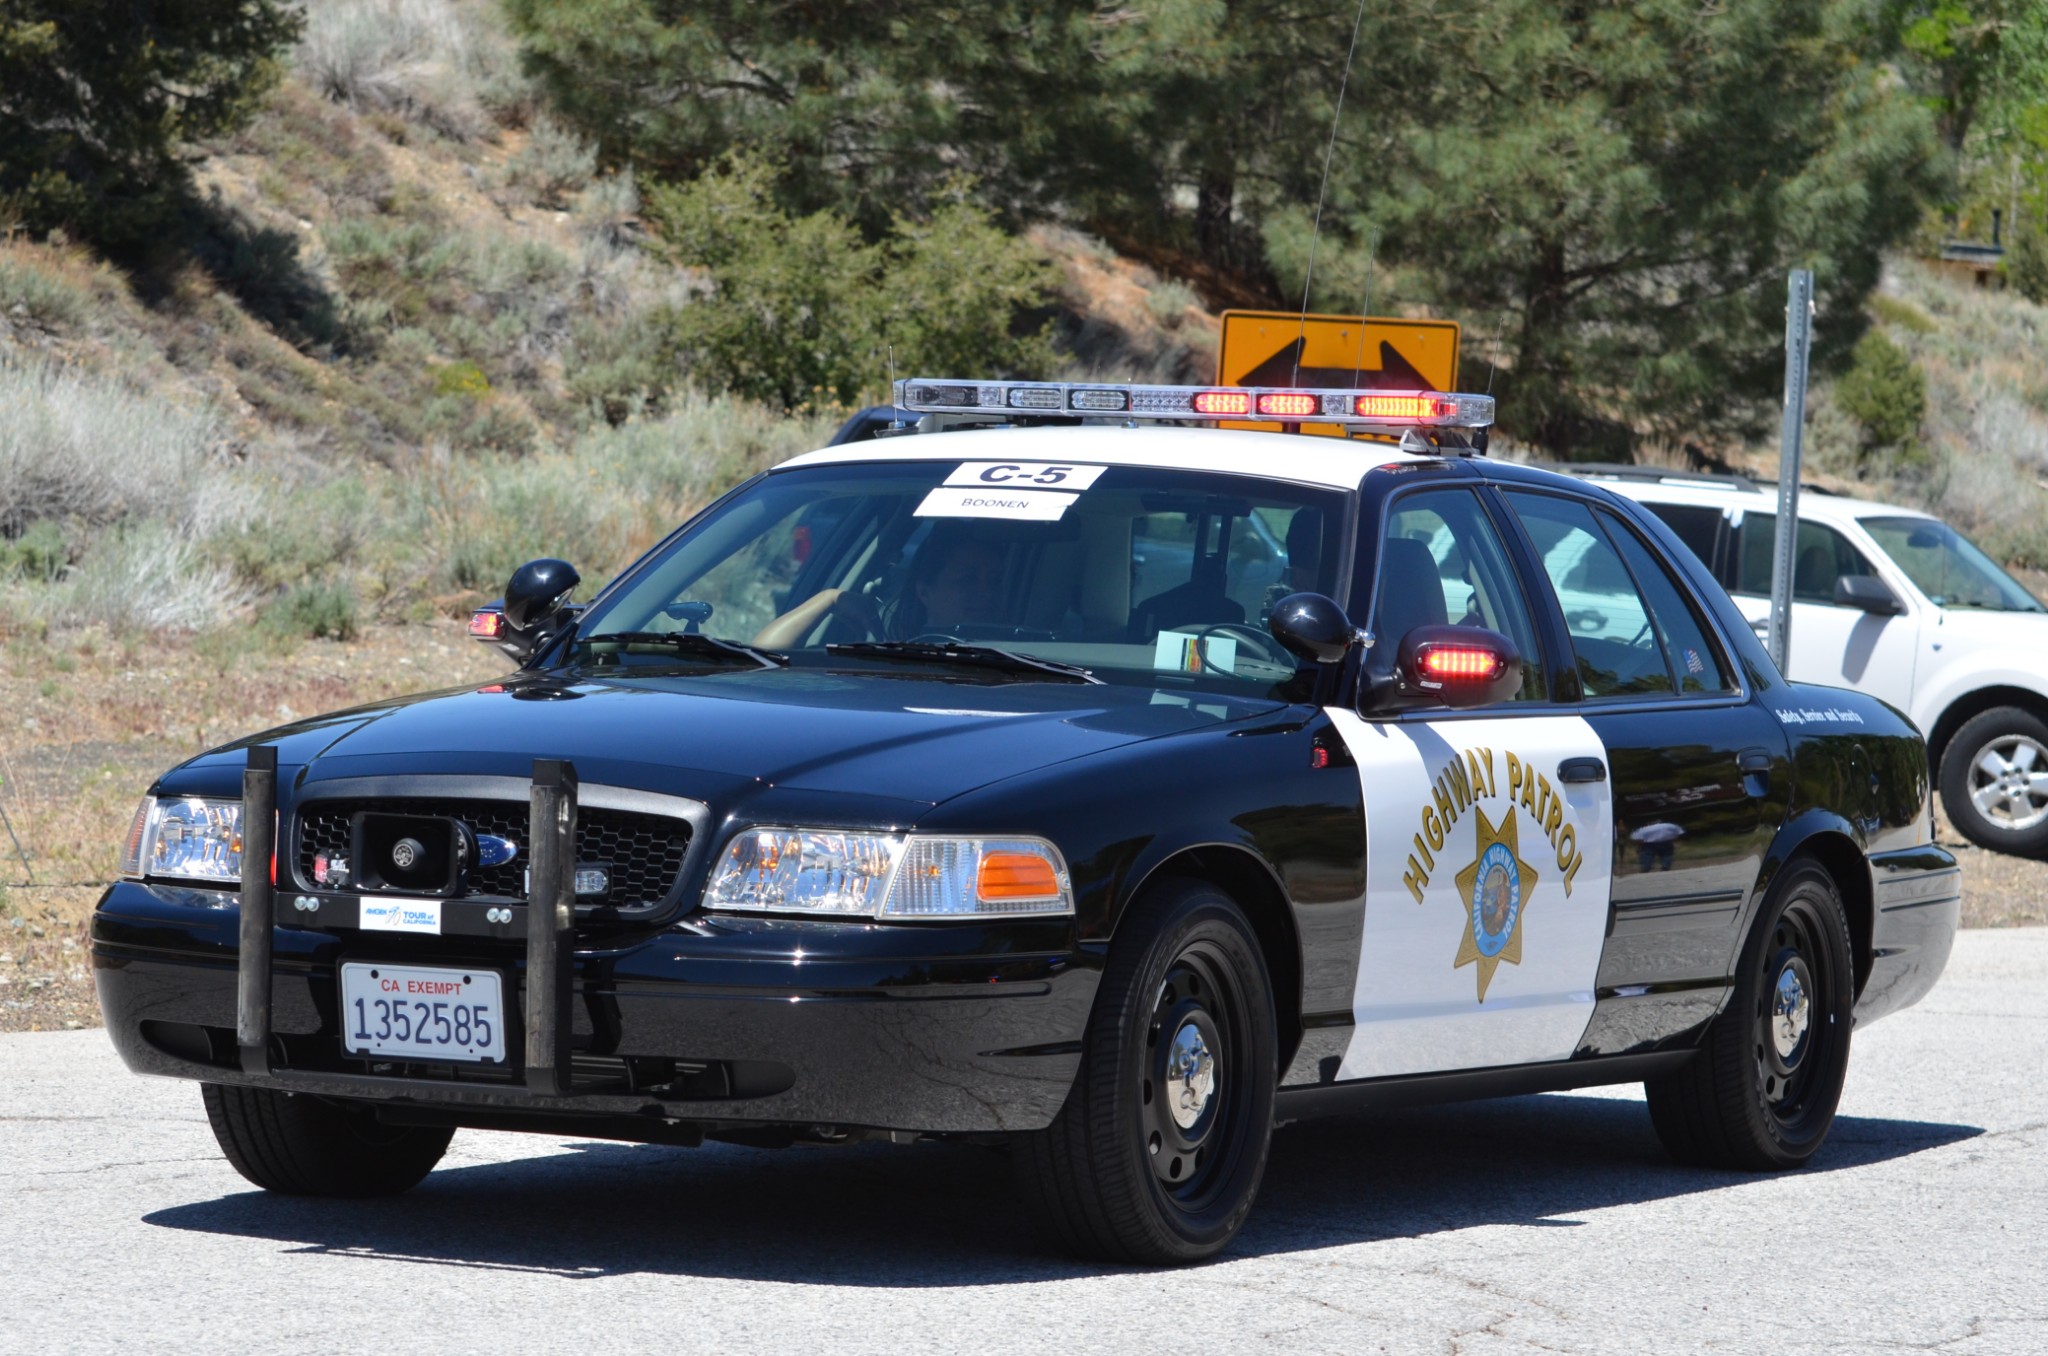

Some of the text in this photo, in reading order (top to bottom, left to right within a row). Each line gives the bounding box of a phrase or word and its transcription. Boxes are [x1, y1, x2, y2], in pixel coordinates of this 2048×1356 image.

[979, 465, 1073, 484] C-5
[961, 498, 1030, 509] BOONEN
[1402, 747, 1583, 905] HIGHWAY PATROL
[1473, 846, 1519, 941] CALIFORNIA HIGHWAY PATROL
[403, 911, 427, 919] TOUR
[381, 979, 462, 995] CA EXEMPT
[354, 998, 492, 1047] 1352585
